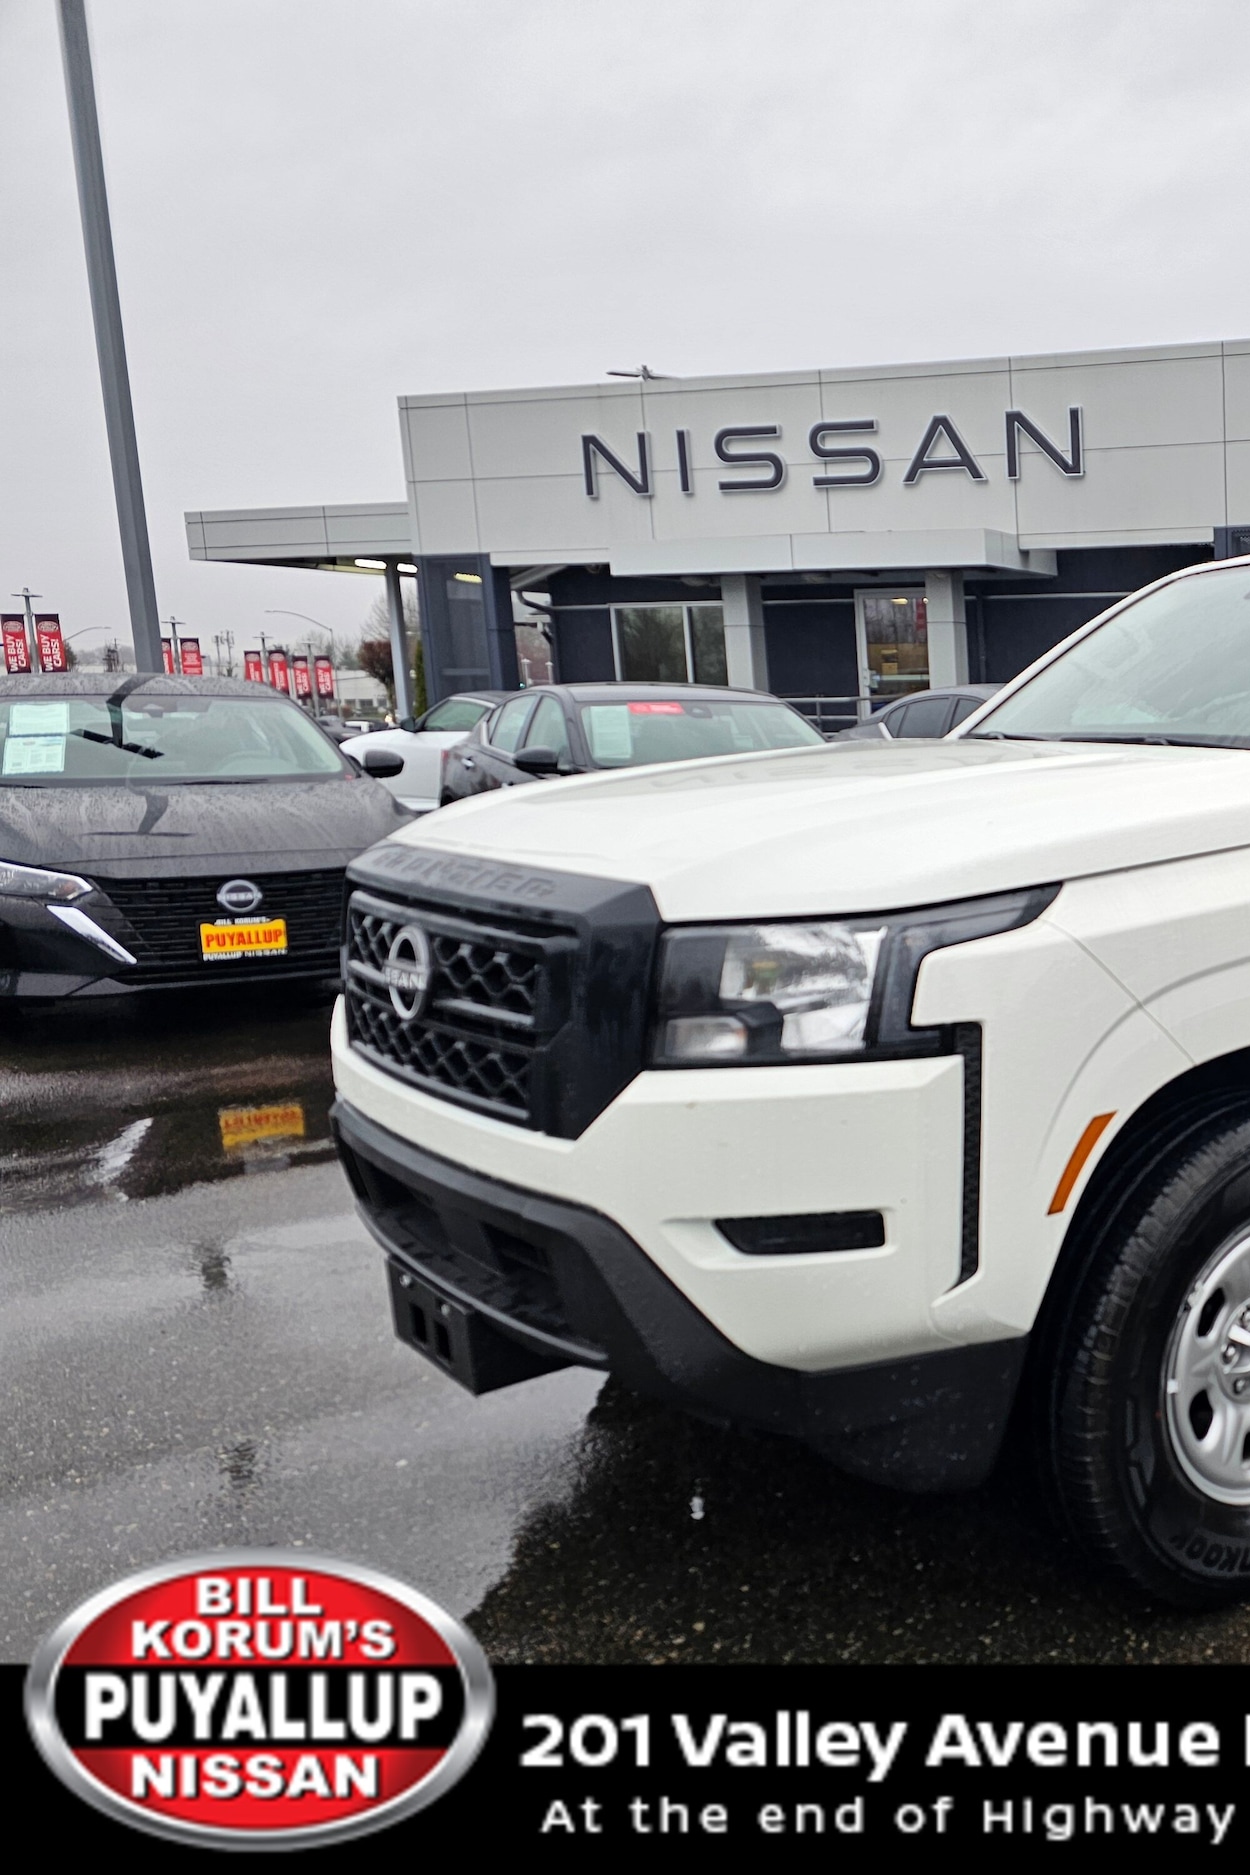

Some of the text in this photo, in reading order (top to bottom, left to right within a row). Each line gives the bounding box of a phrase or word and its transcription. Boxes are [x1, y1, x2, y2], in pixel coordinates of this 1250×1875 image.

[581, 406, 1085, 498] NISSAN
[6, 634, 16, 654] BUY
[15, 639, 26, 667] CARS!
[40, 634, 51, 654] BUY
[50, 639, 61, 667] CARS!
[8, 656, 18, 671] WE
[43, 656, 53, 671] WE
[205, 928, 283, 948] PUYALLUP
